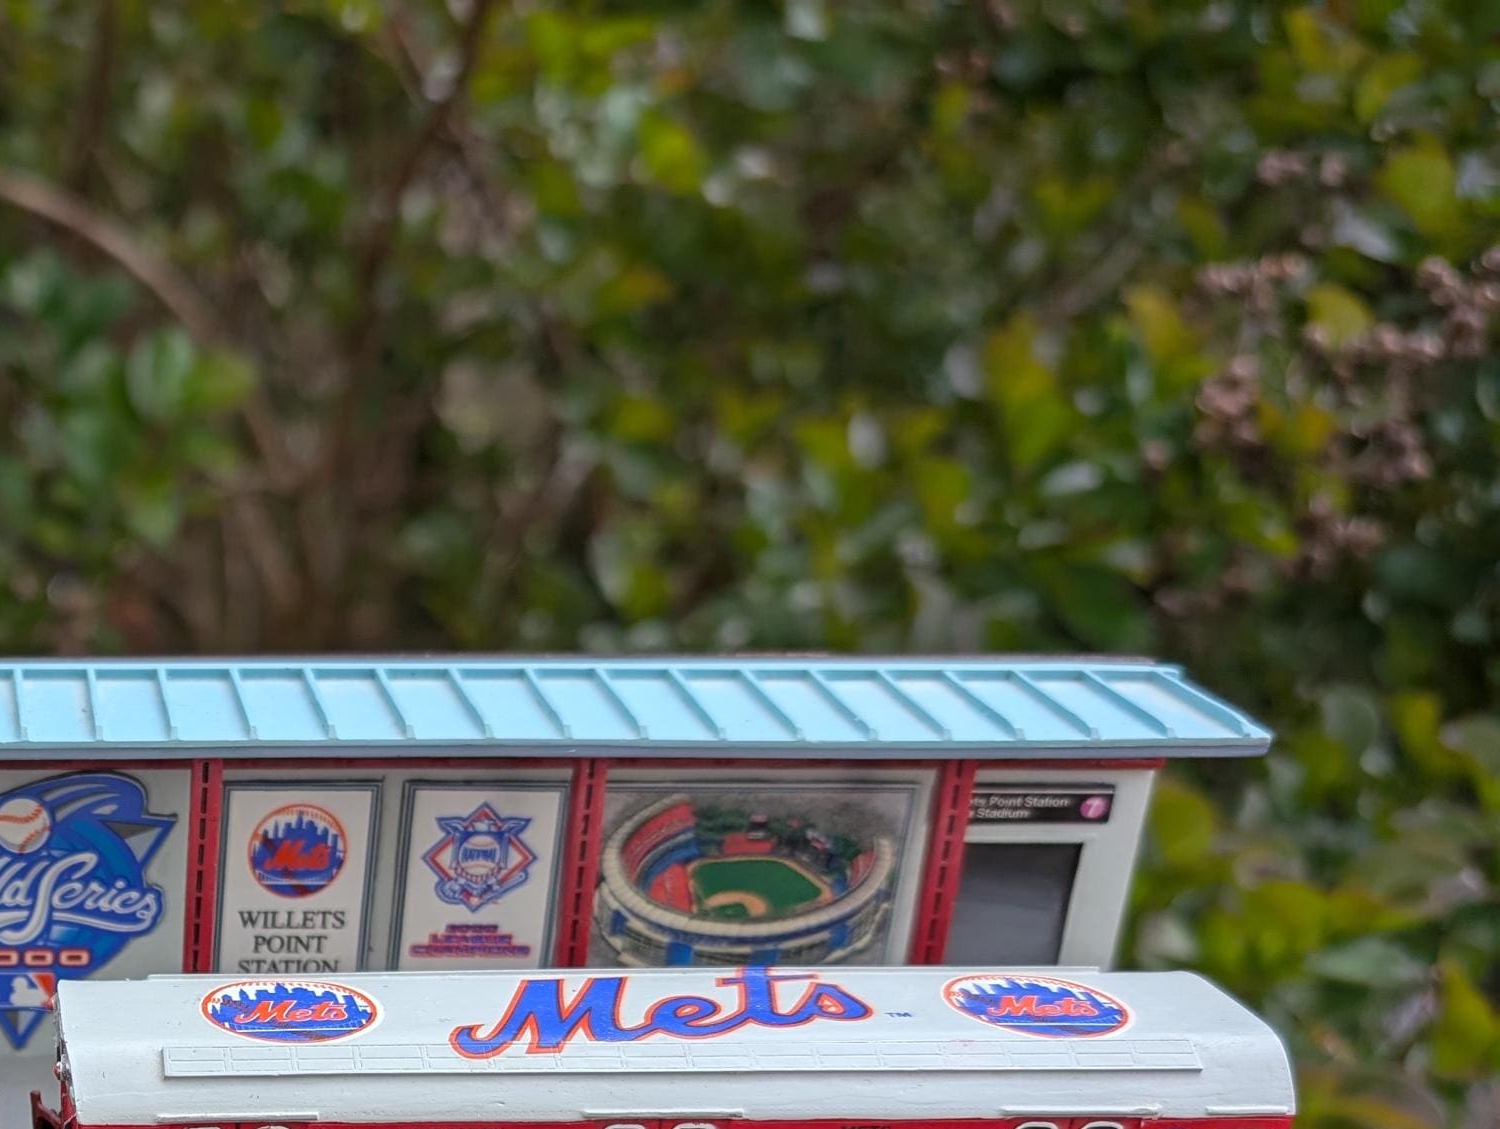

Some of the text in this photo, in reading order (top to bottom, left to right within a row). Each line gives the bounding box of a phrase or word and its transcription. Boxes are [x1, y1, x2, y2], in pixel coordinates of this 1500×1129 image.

[989, 797, 1022, 806] Point
[1025, 796, 1069, 807] Station
[976, 808, 1029, 818] Stadium
[238, 911, 346, 929] WILLETS
[253, 936, 328, 954] POINT
[236, 999, 348, 1023] Mets
[449, 965, 874, 1060] Mets
[987, 995, 1098, 1017] Mets
